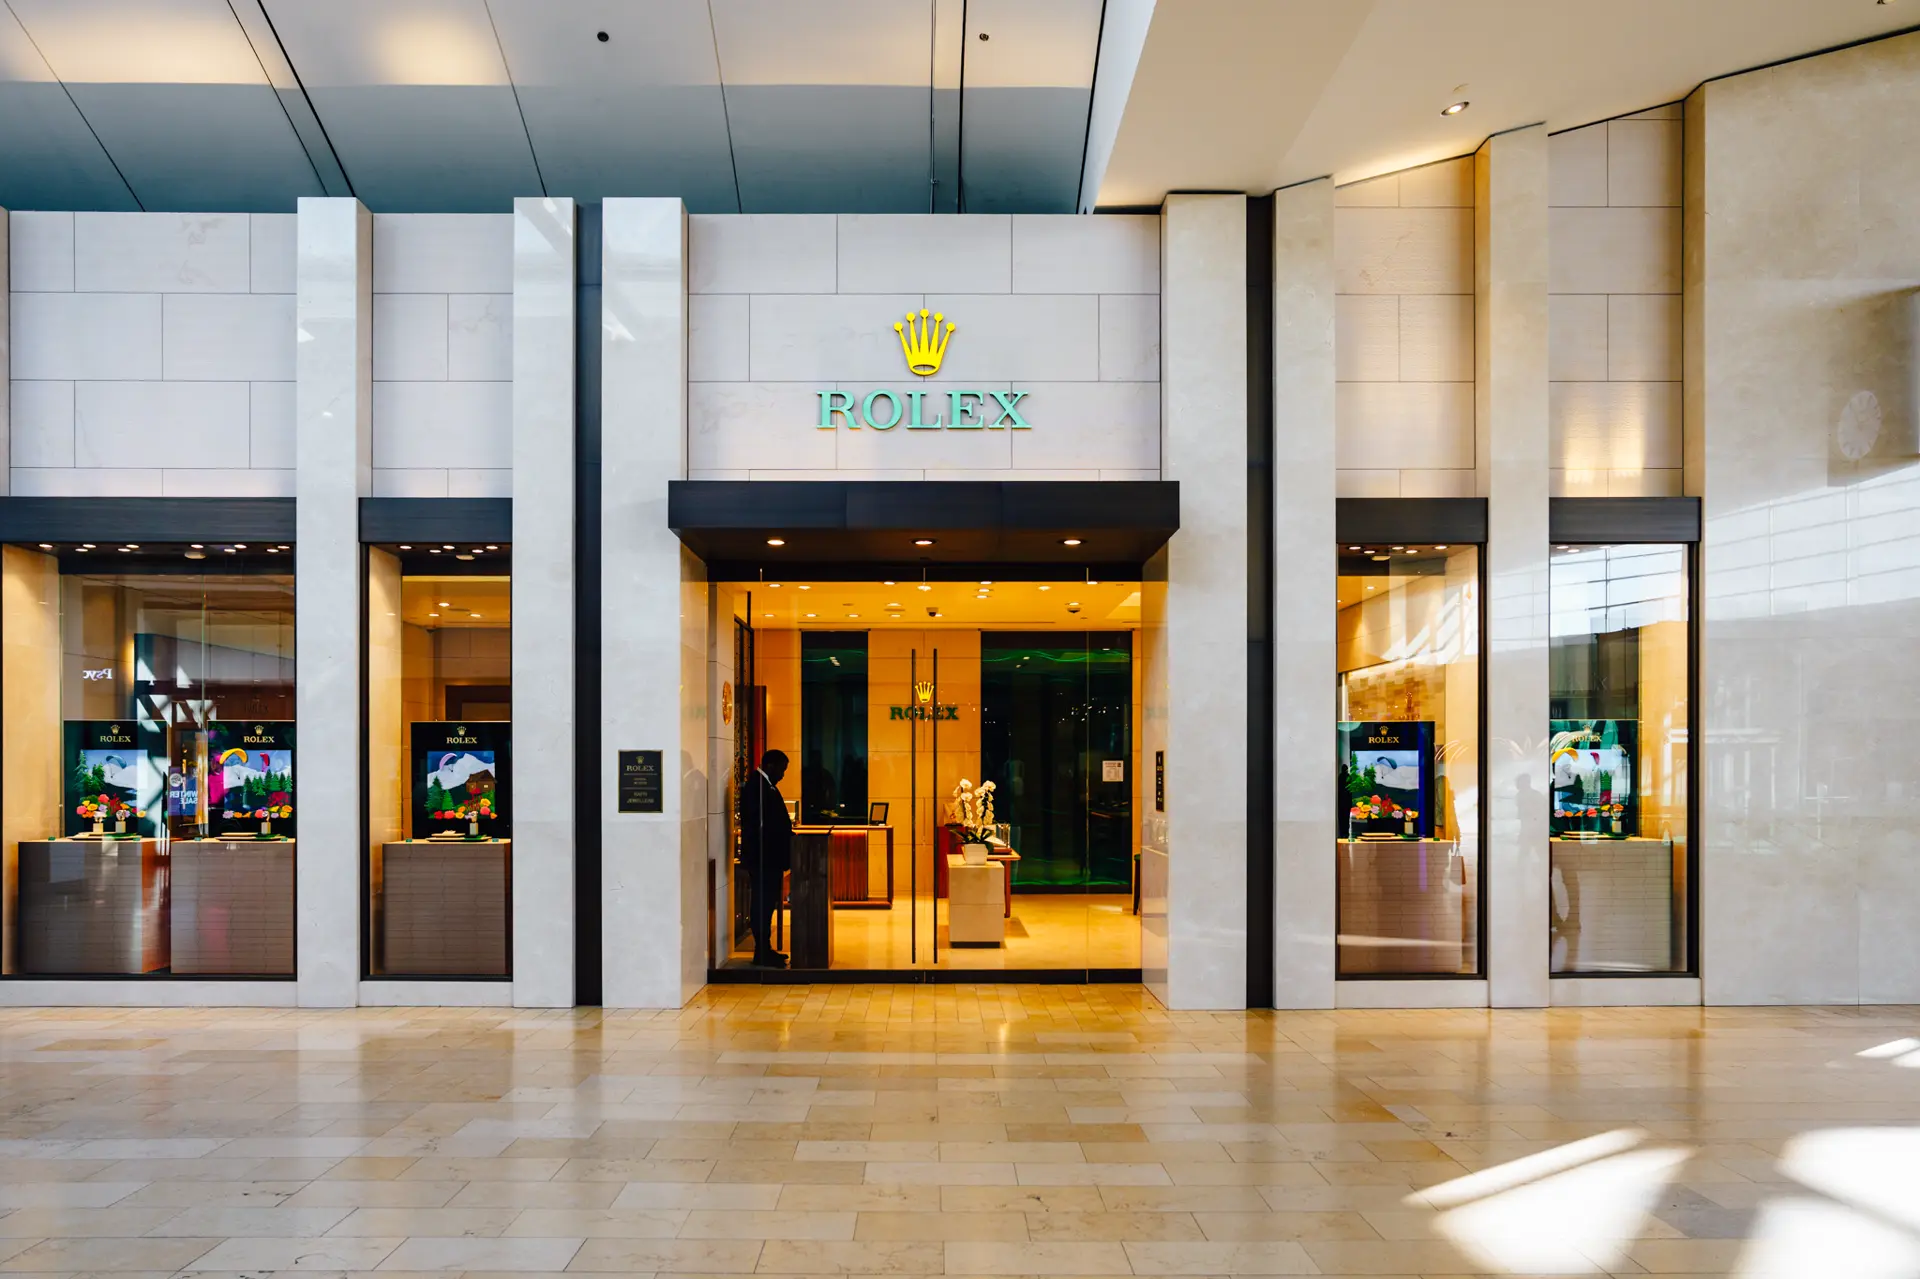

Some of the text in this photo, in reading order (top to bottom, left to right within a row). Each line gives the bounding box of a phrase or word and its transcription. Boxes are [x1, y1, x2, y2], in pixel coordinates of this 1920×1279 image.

[815, 389, 1033, 431] ROLEX
[889, 706, 959, 721] ROLEX
[100, 735, 131, 743] ROLEX
[243, 735, 275, 743] ROLEX
[1368, 736, 1400, 744] ROLEX
[1571, 734, 1602, 743] ROLEX
[626, 764, 655, 772] ROLEX
